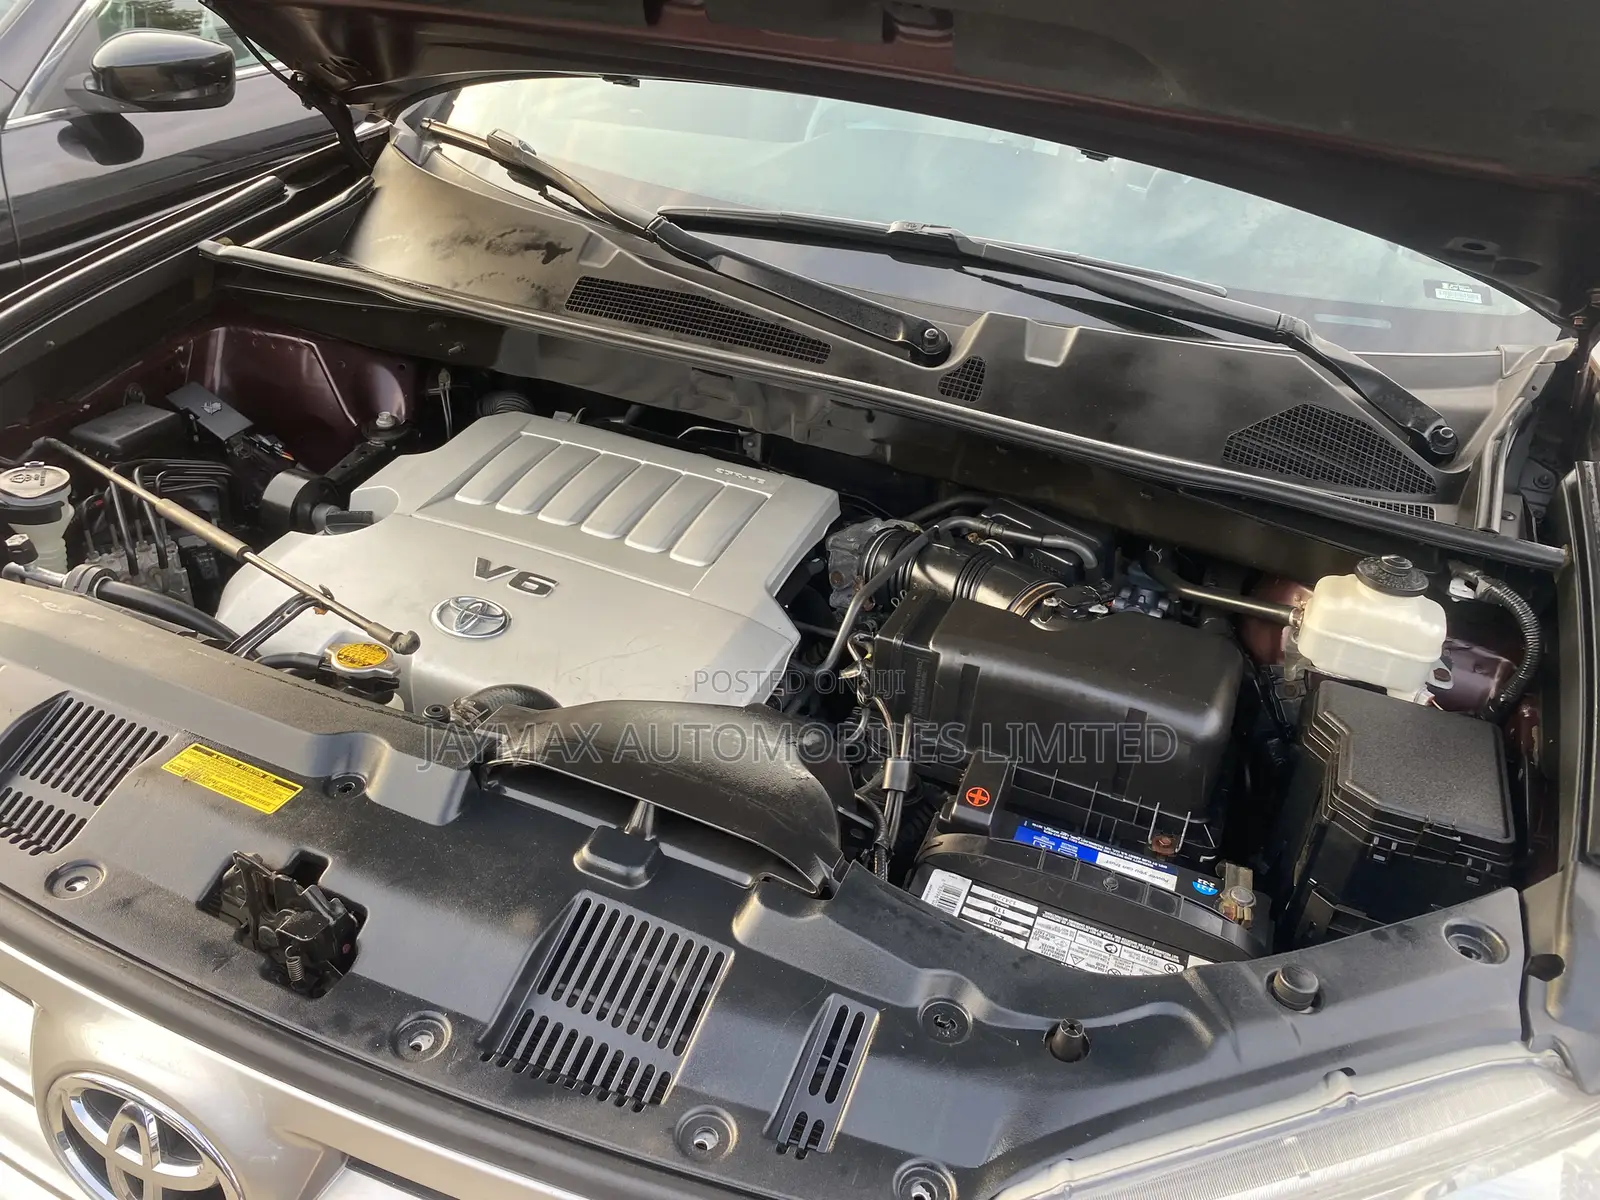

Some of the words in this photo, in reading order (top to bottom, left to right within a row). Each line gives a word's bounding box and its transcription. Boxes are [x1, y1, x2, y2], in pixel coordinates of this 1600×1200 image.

[473, 556, 559, 598] V6
[1103, 858, 1120, 868] trust
[1134, 866, 1147, 875] you
[1147, 871, 1169, 883] Power
